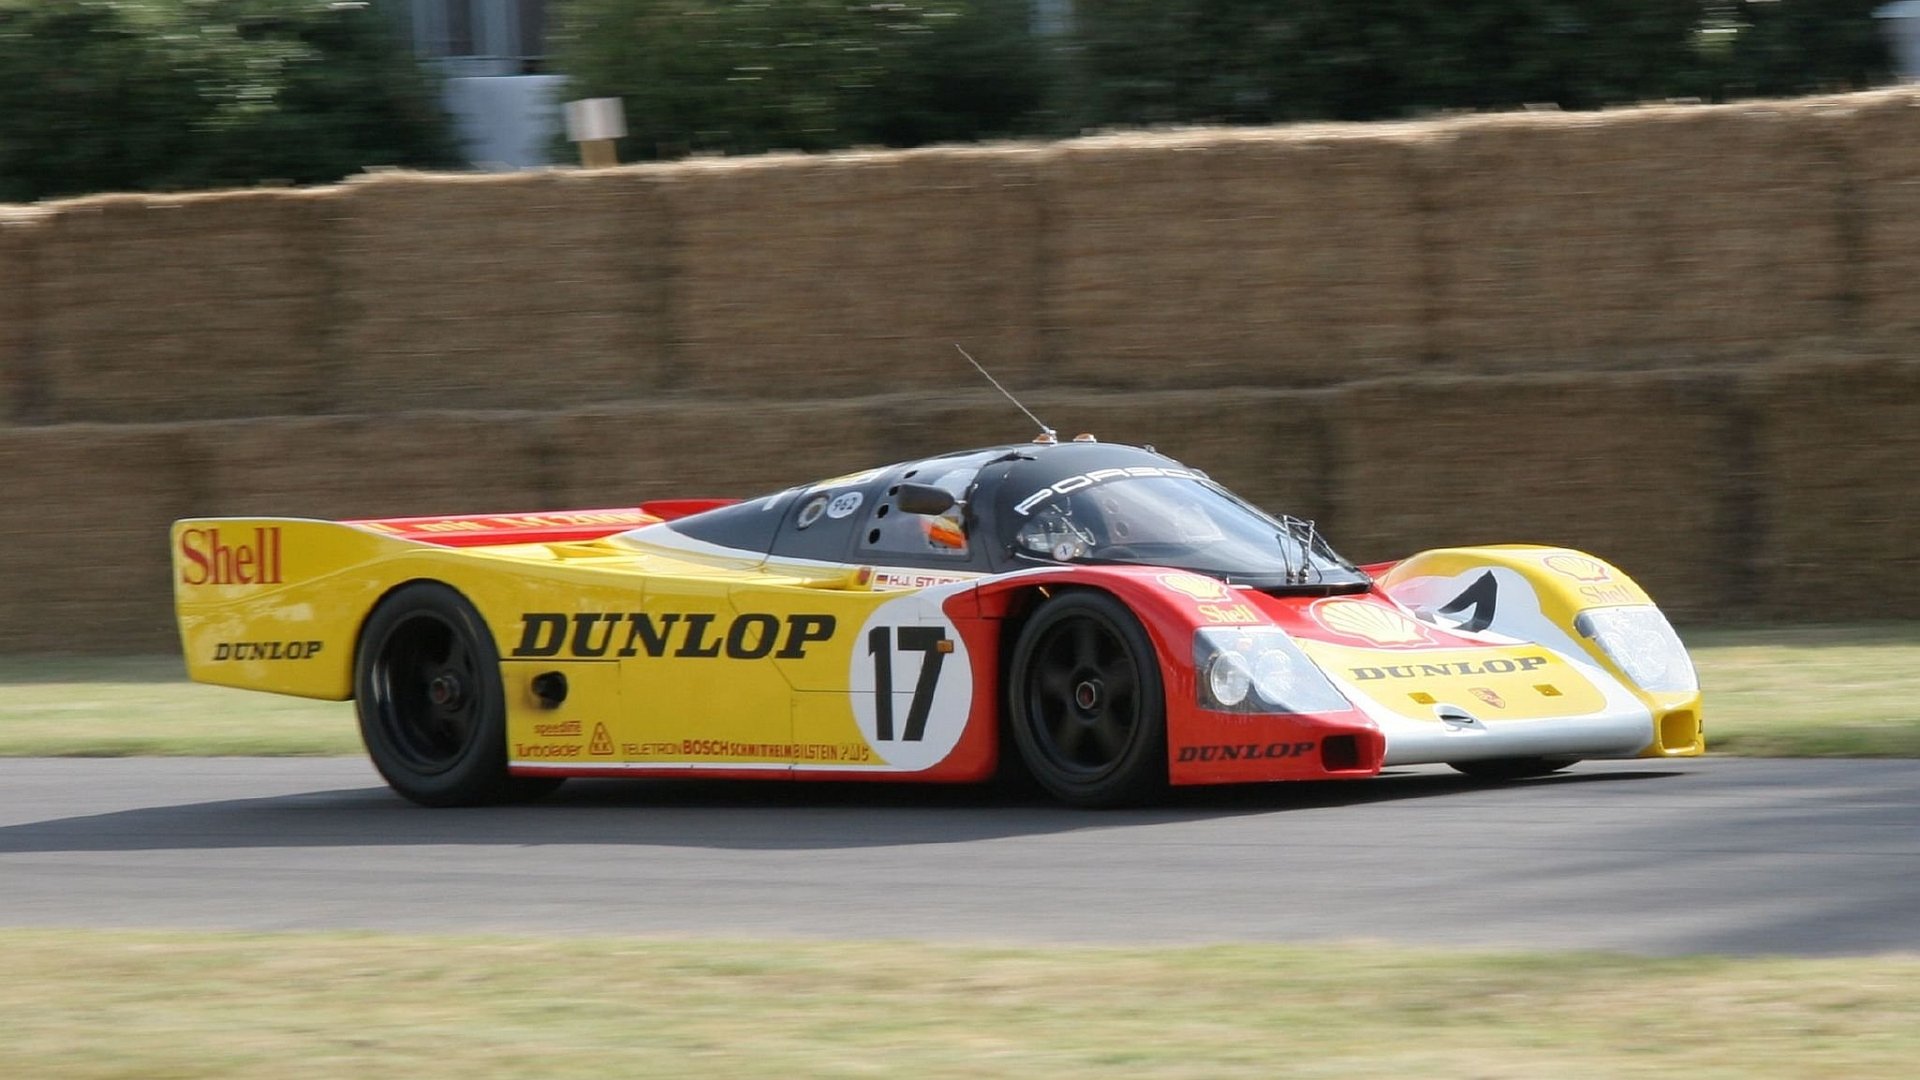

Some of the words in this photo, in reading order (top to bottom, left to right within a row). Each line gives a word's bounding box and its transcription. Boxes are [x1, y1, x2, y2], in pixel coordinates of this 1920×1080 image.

[180, 526, 282, 586] Shell
[1579, 584, 1636, 605] Shell
[1197, 604, 1259, 623] Shell
[511, 612, 837, 661] DUNLOP
[213, 640, 323, 662] DUNLOP
[1348, 656, 1548, 681] DUNLOP
[868, 625, 947, 742] 17
[682, 739, 729, 756] BOSCH
[1177, 741, 1316, 763] DUNLOP
